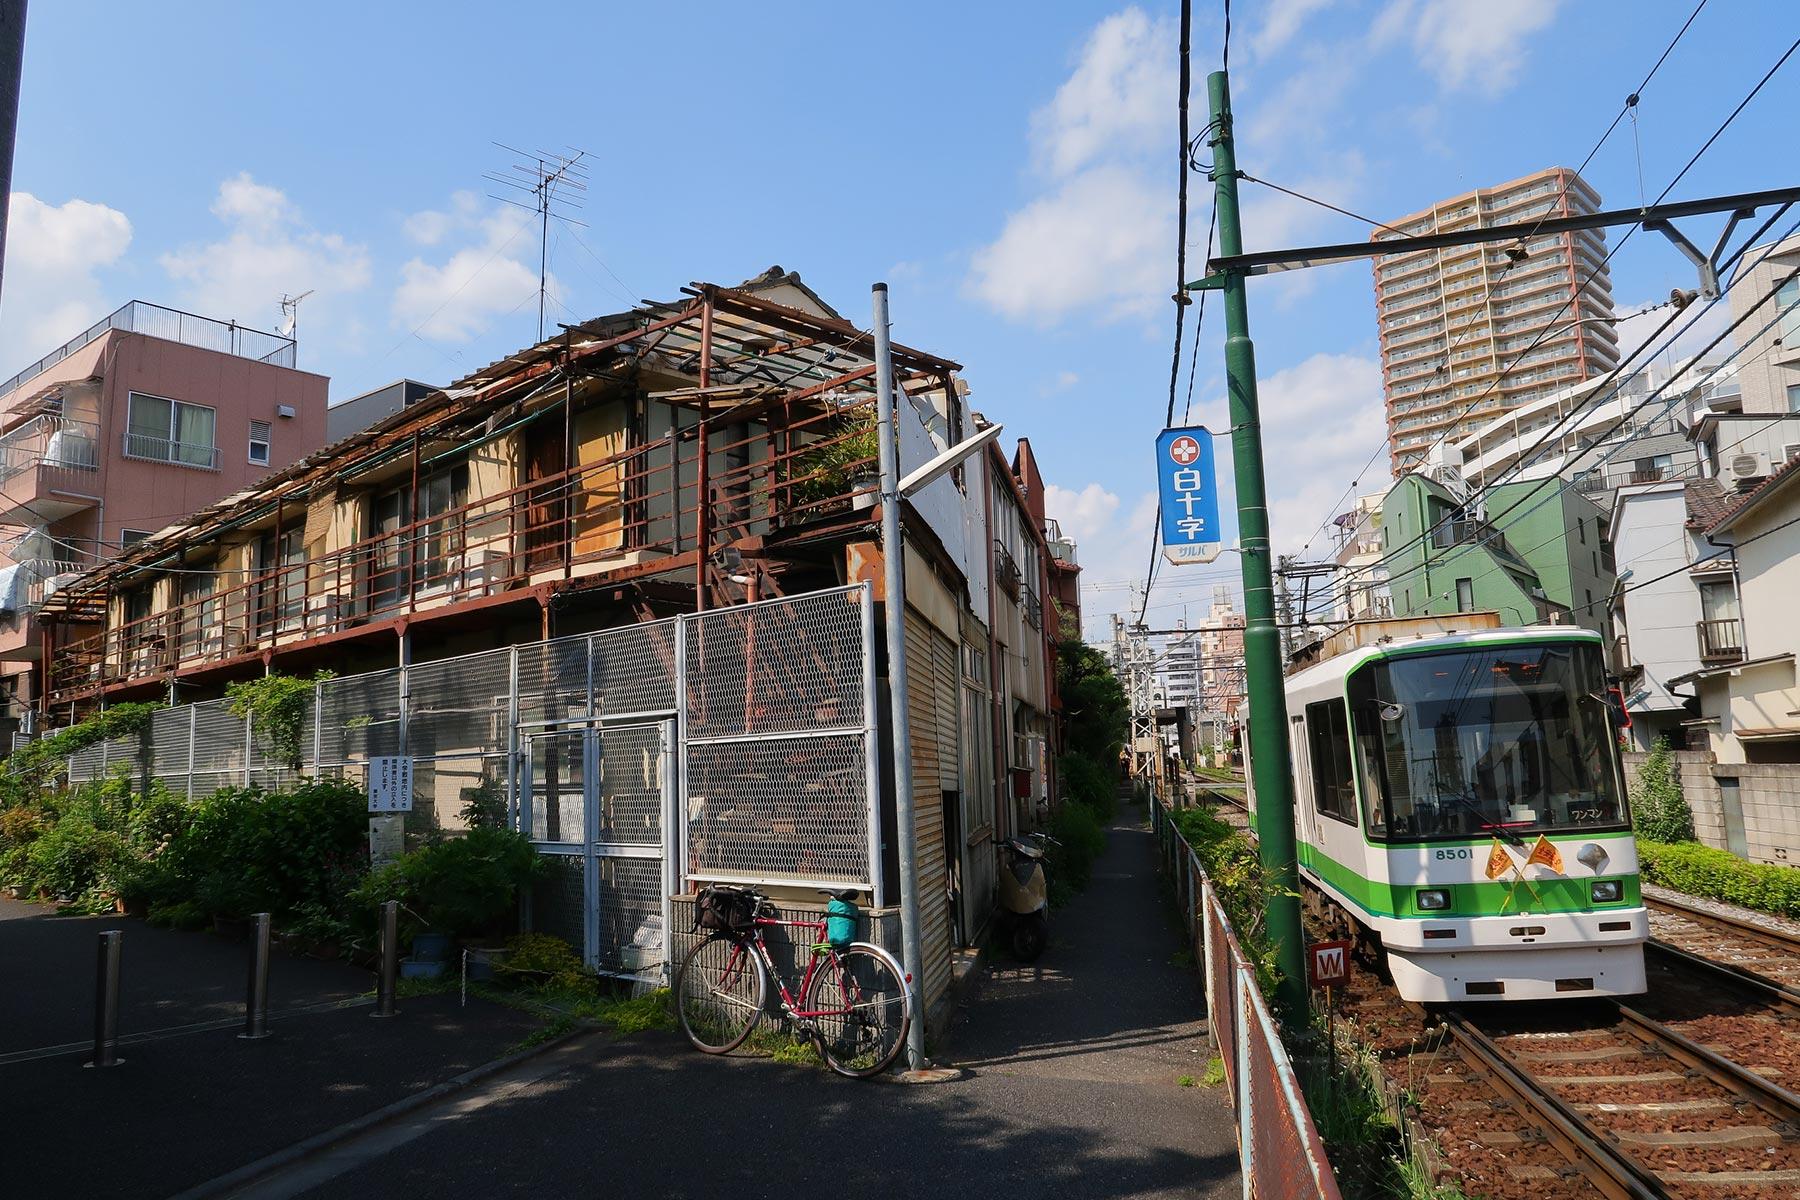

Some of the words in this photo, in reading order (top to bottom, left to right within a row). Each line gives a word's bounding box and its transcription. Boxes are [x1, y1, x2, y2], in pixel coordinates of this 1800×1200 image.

[1174, 467, 1204, 540] 白十字
[1571, 808, 1603, 820] ワンマン
[1436, 848, 1474, 861] 8501
[1318, 952, 1342, 976] W
